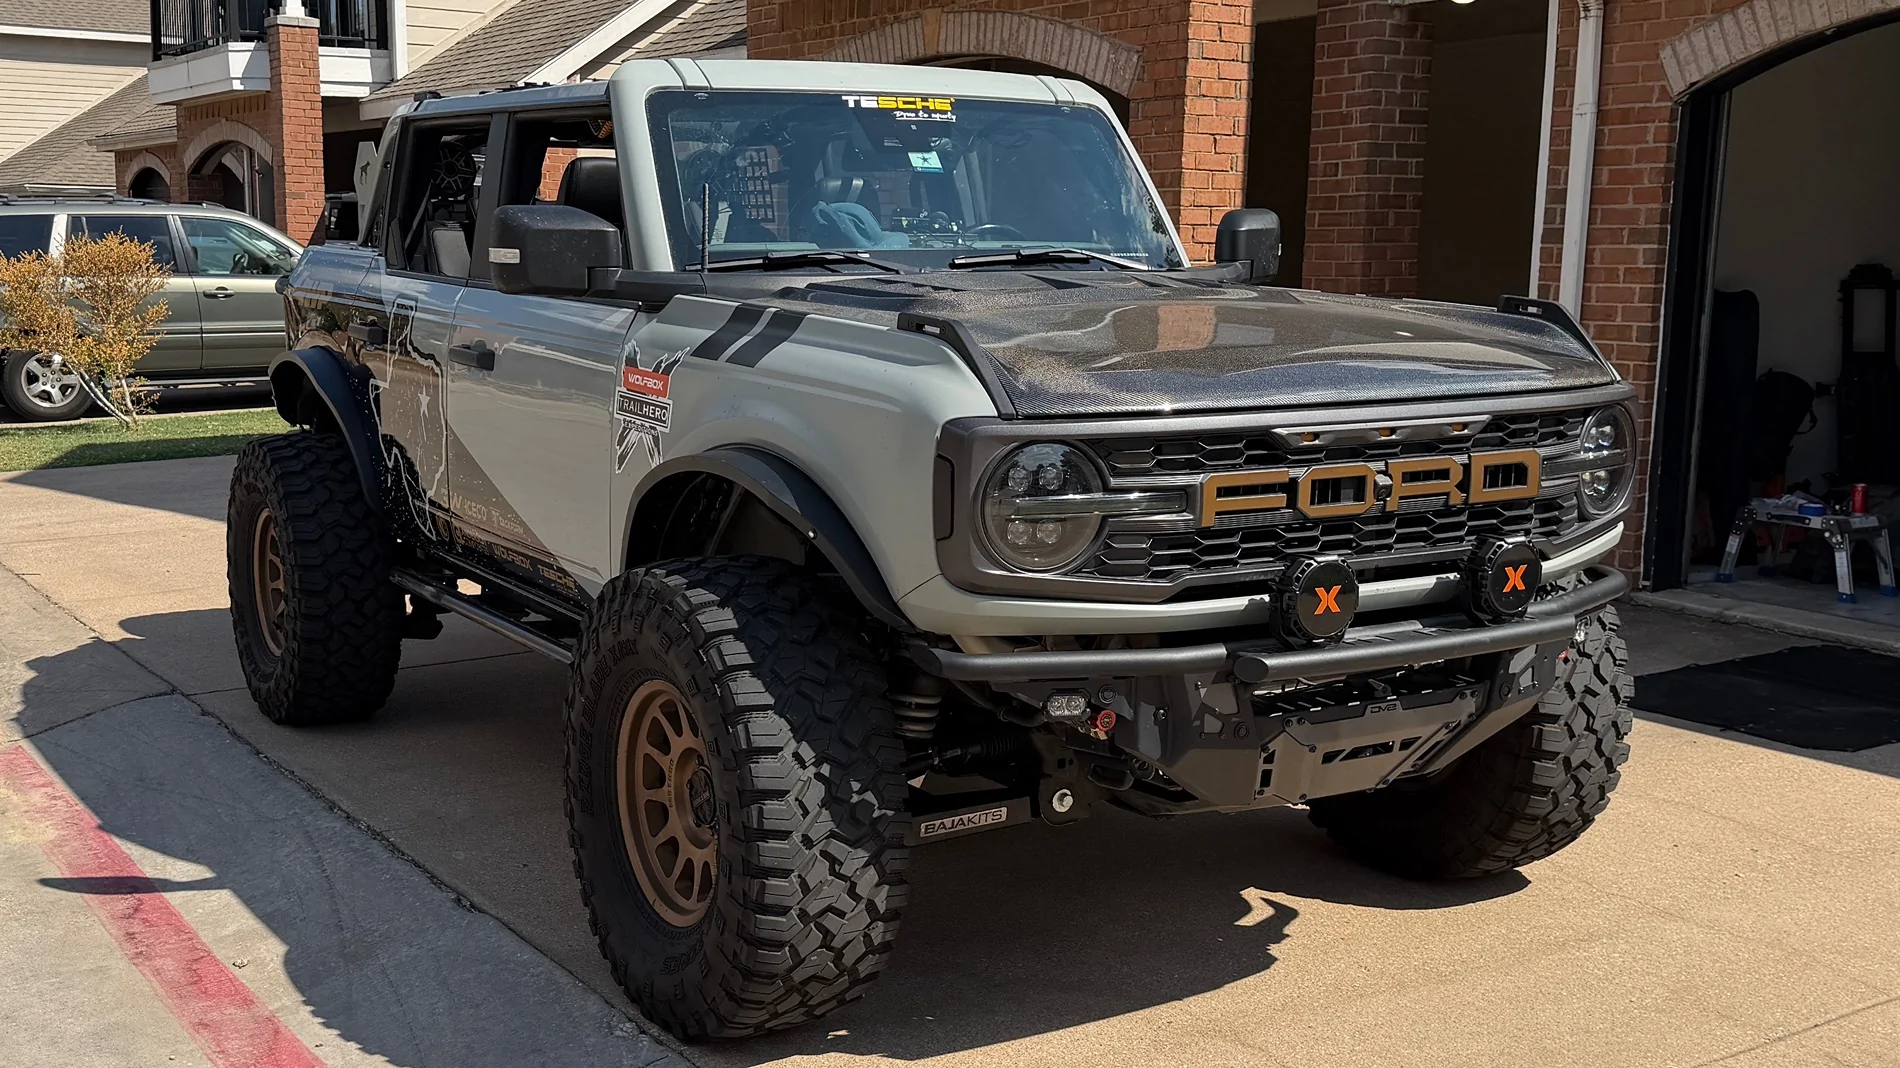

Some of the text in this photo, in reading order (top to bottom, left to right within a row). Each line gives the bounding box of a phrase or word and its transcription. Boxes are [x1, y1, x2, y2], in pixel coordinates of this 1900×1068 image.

[841, 96, 952, 110] TESCHE
[628, 372, 665, 391] WOLFBOX
[619, 397, 668, 421] TRAILHERO
[1199, 448, 1542, 528] FORD
[465, 498, 487, 521] ICECO
[492, 544, 533, 571] WOLFBOX
[1503, 564, 1528, 593] X
[1314, 585, 1342, 615] X
[581, 655, 613, 727] BLADE
[923, 809, 1004, 835] BAJAKITS
